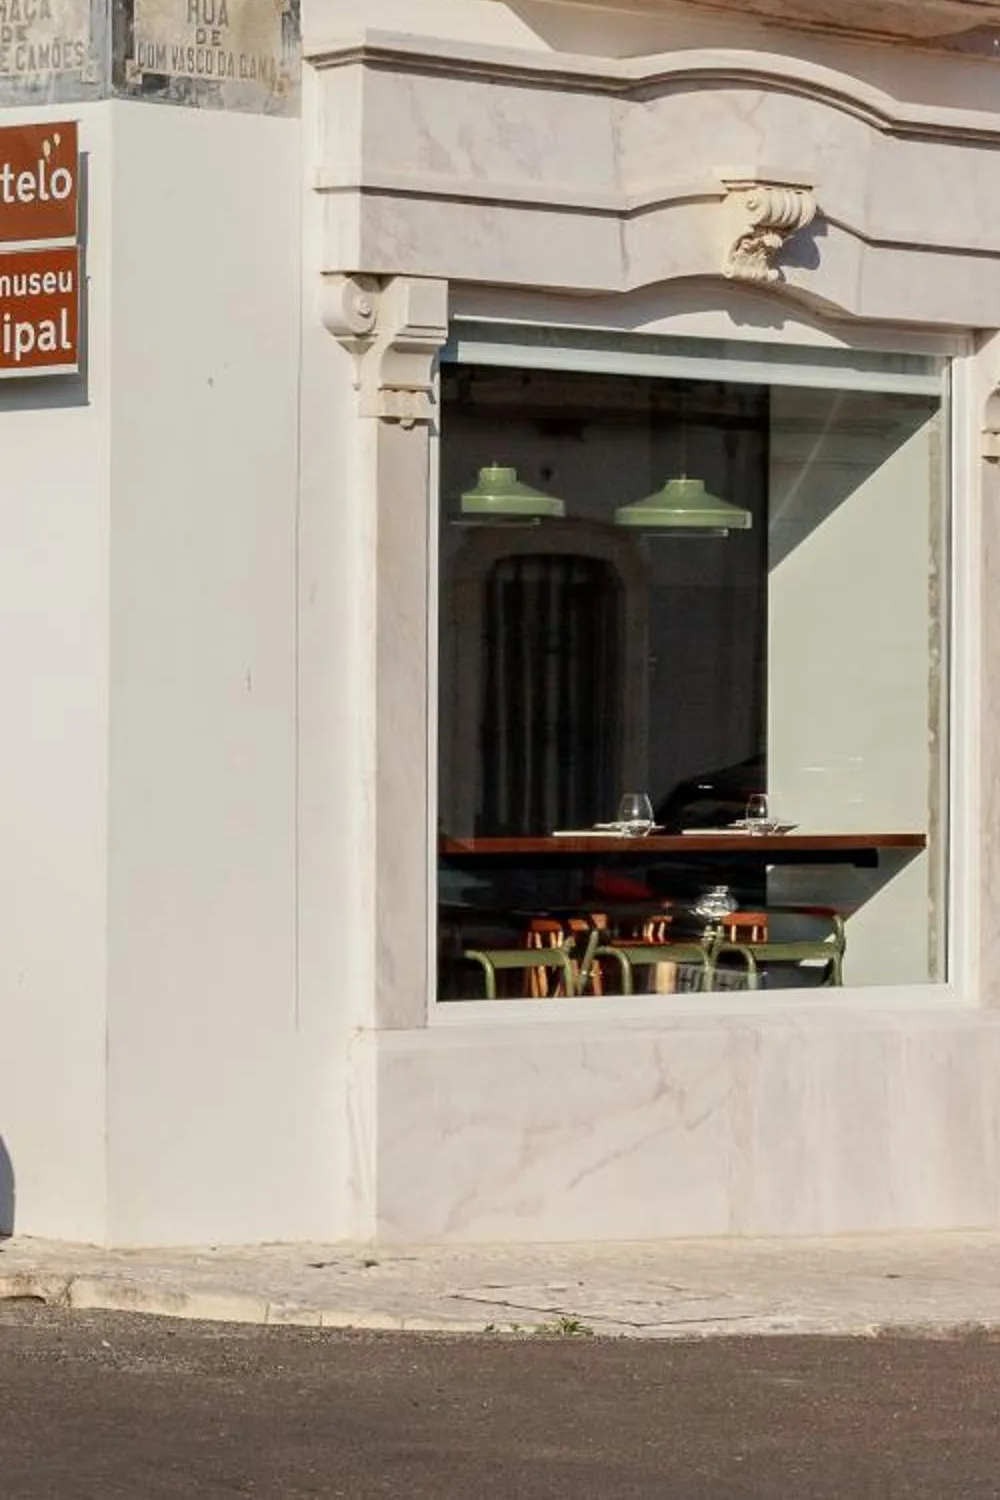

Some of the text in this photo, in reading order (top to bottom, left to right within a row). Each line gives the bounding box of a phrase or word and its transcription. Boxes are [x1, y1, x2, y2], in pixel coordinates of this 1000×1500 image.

[16, 37, 85, 71] CAMÕES
[196, 28, 221, 47] DE
[172, 44, 213, 75] VASCO
[218, 50, 235, 77] DA
[240, 53, 277, 91] GAMA
[3, 308, 73, 361] ipal
